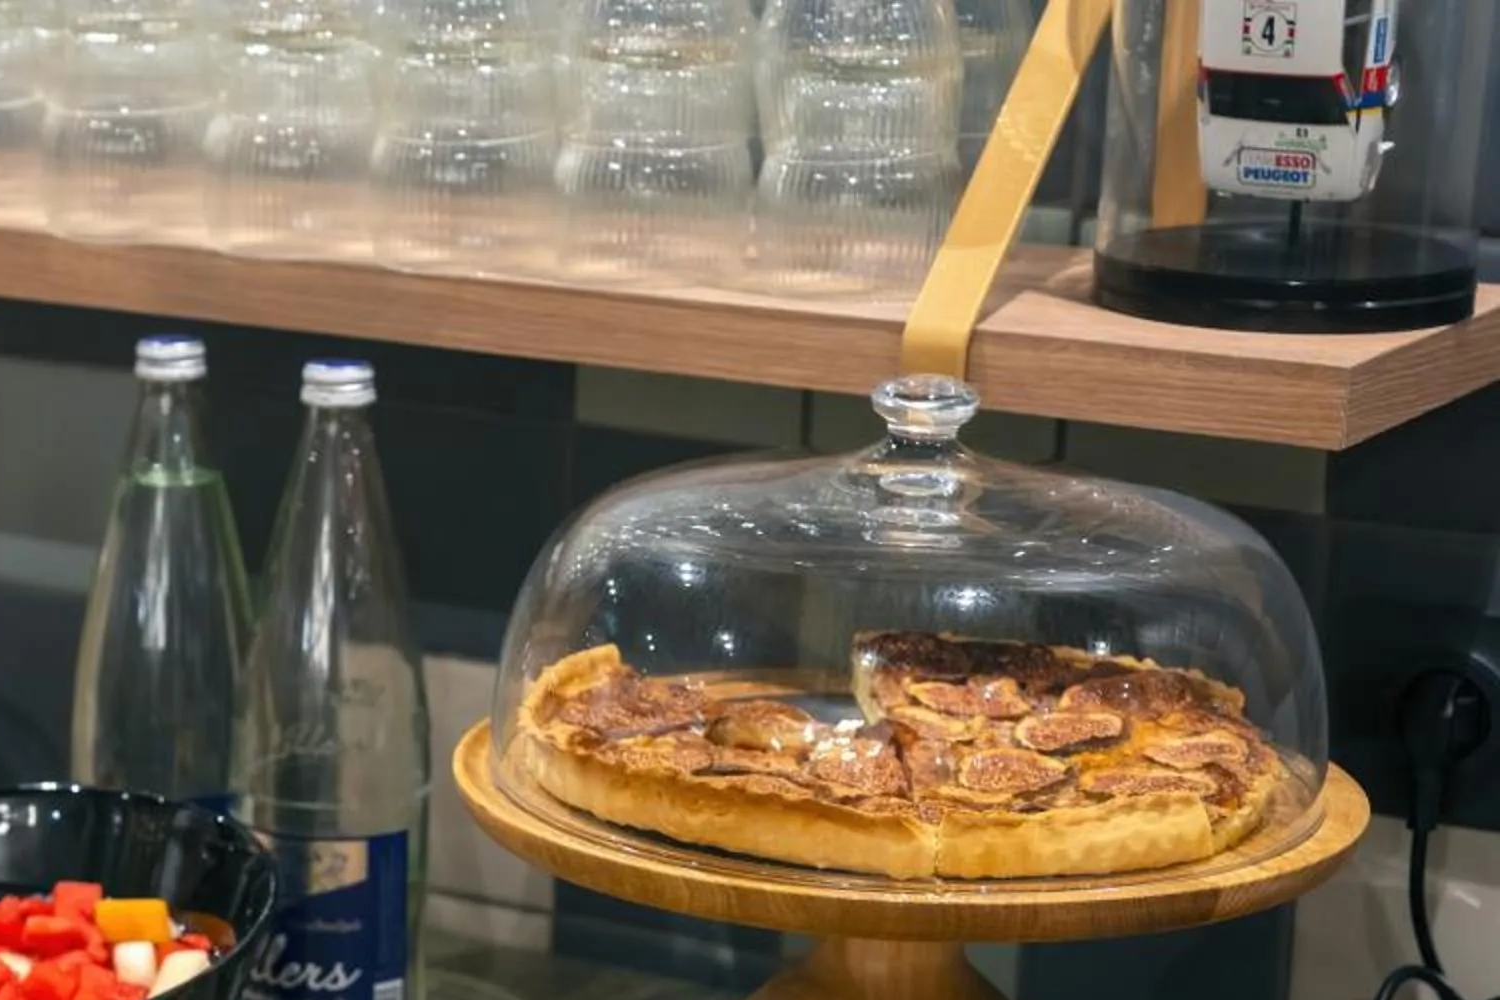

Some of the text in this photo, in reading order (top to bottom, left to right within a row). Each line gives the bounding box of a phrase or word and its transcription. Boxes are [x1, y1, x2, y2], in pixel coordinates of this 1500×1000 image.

[1261, 16, 1275, 46] 4
[1275, 154, 1311, 168] ESSO
[1243, 166, 1310, 183] PEUGEOT
[250, 931, 363, 992] llers
